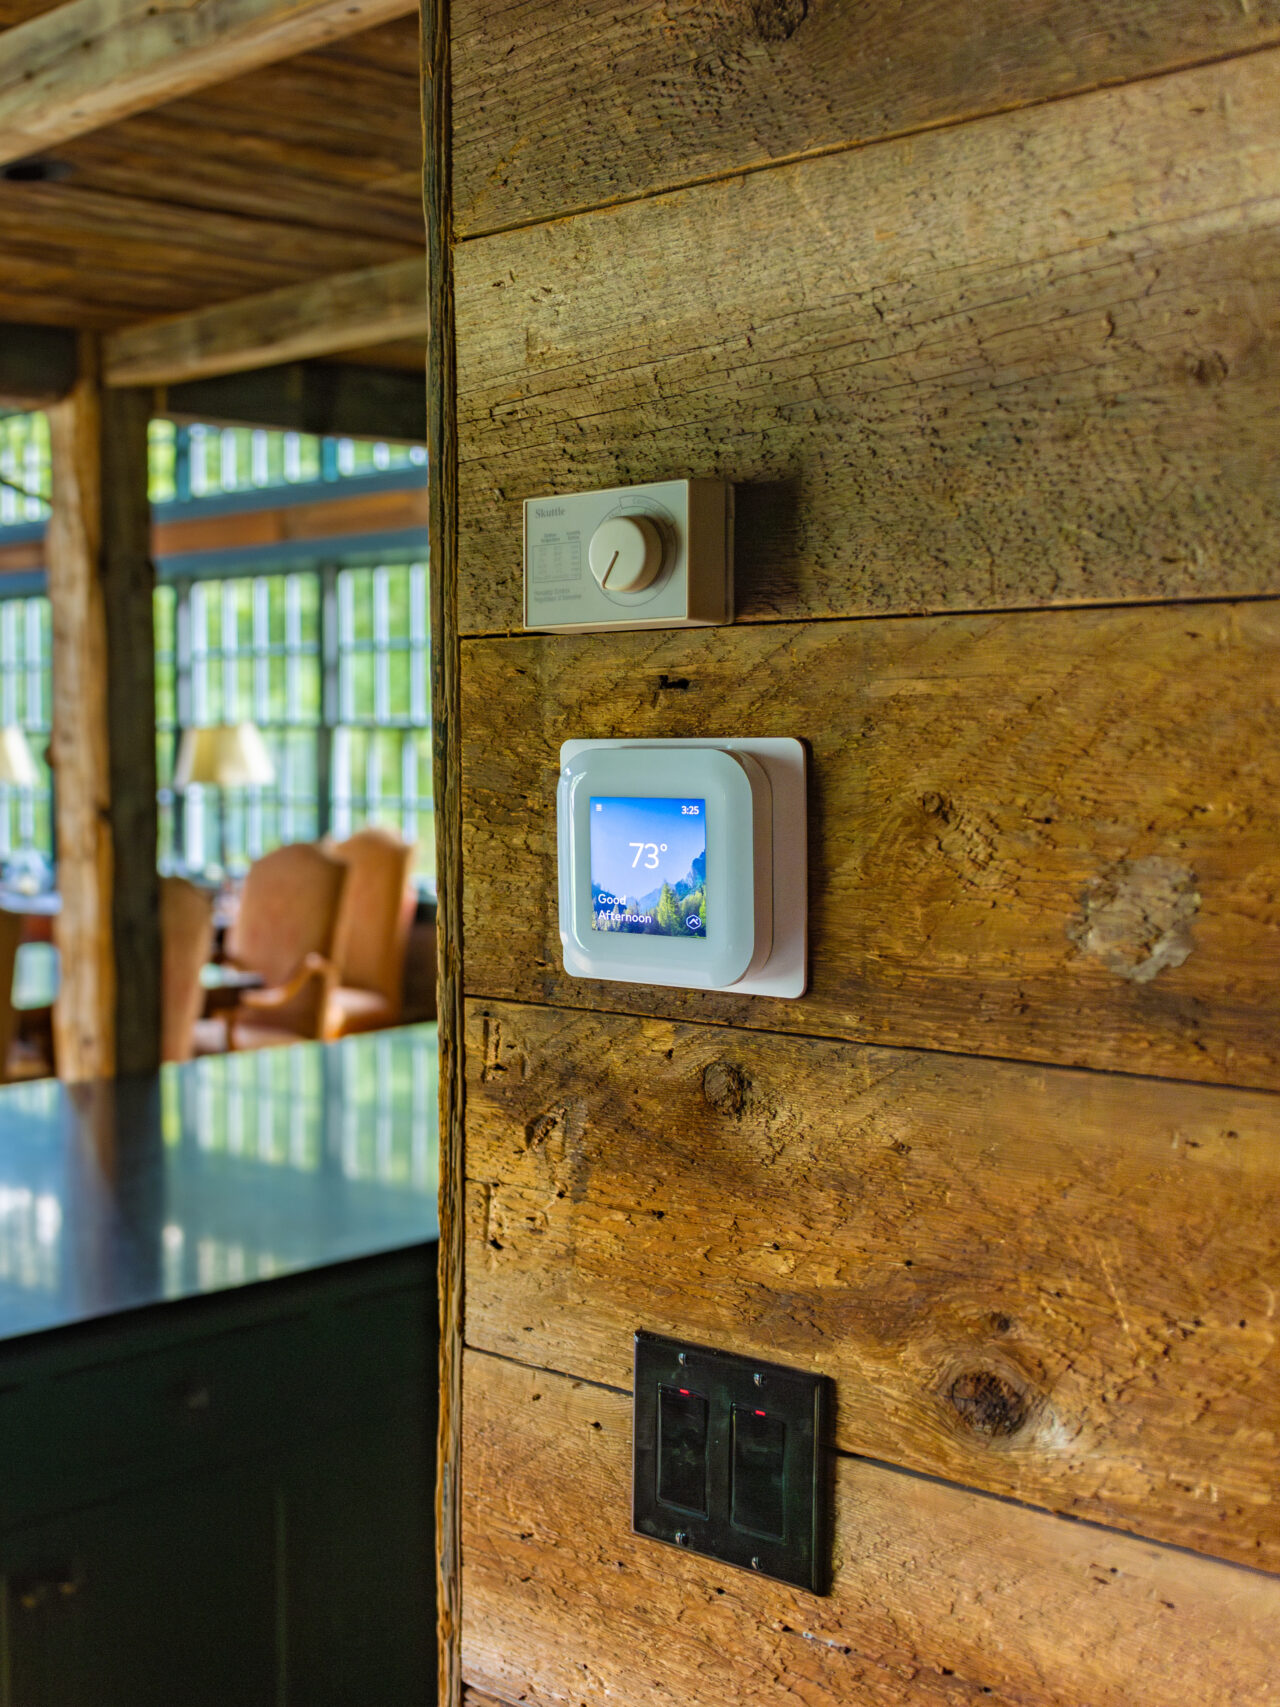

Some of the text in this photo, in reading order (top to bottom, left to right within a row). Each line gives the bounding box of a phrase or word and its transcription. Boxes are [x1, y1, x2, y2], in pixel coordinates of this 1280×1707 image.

[535, 507, 566, 519] Skuttle
[681, 805, 700, 815] 3:25
[628, 842, 668, 869] 73°
[598, 893, 627, 906] Good
[598, 911, 652, 924] Afternoon
